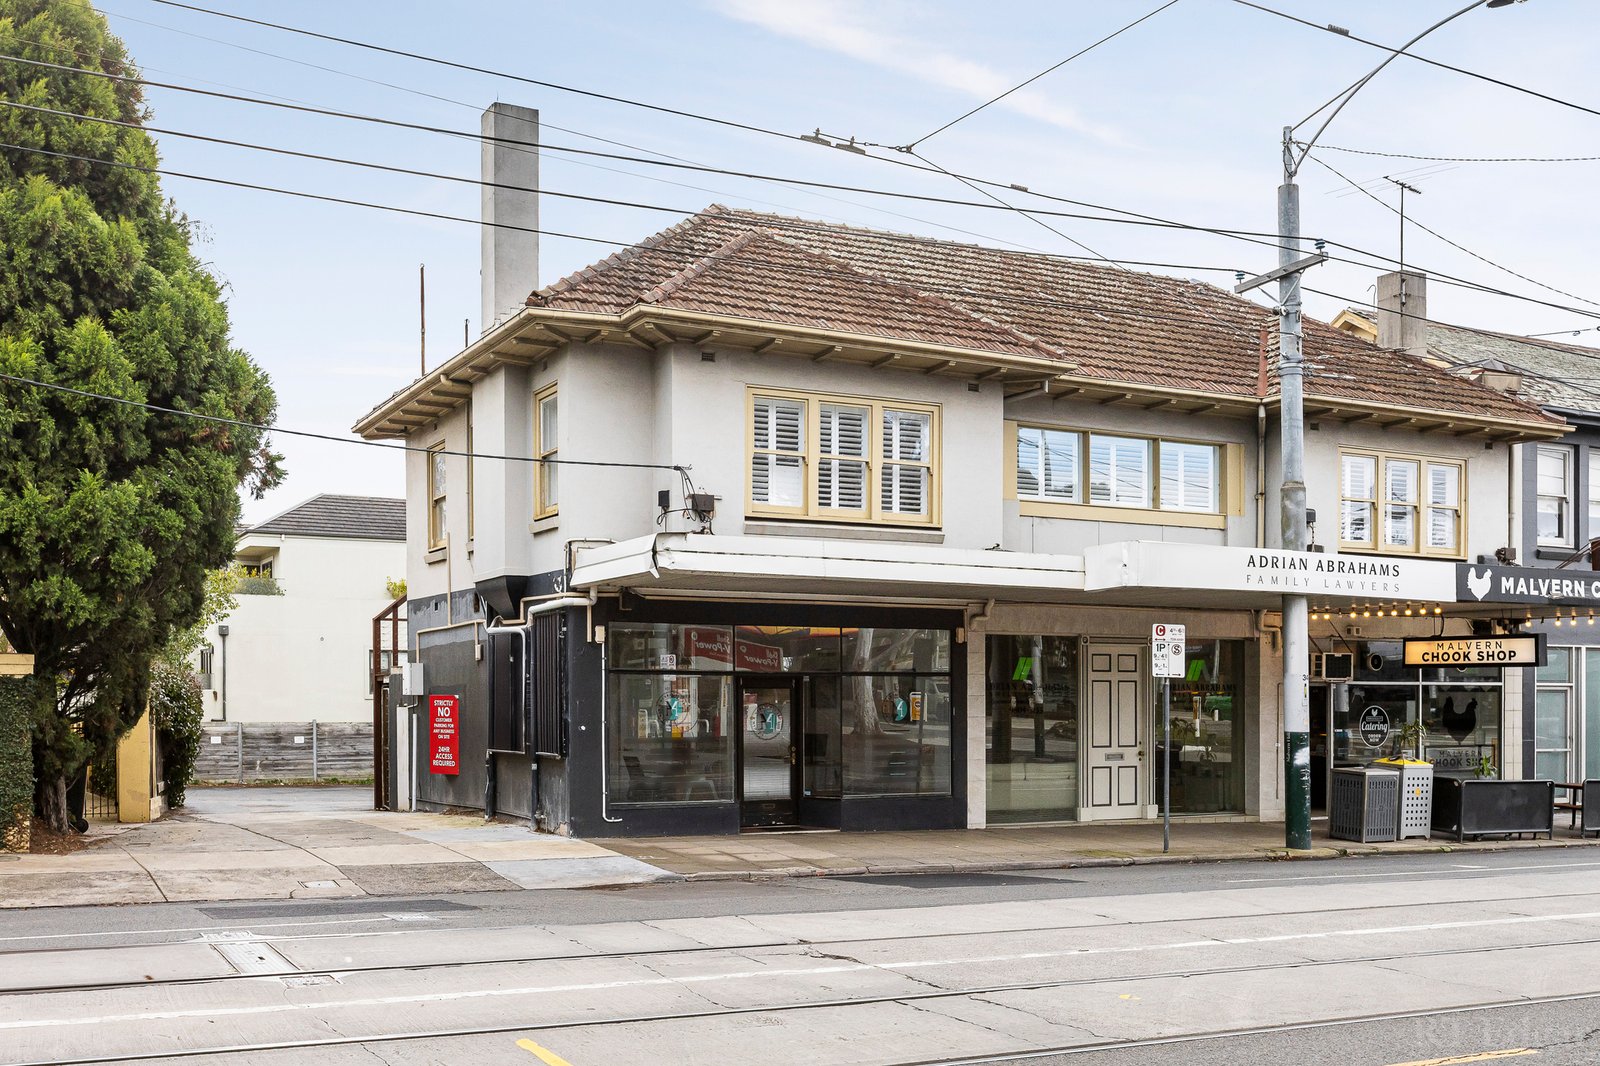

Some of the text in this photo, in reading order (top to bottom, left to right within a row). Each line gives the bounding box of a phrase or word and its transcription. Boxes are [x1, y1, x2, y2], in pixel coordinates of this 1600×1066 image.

[1247, 555, 1400, 577] ADRIAN ABRAHAMS
[1246, 574, 1400, 593] FAMILY LAWYERS
[1501, 576, 1585, 598] MALVERN
[1436, 640, 1503, 651] MALVERN
[1421, 650, 1517, 662] CHOOK SHOP
[438, 707, 450, 717] NO
[1361, 720, 1388, 733] Catering
